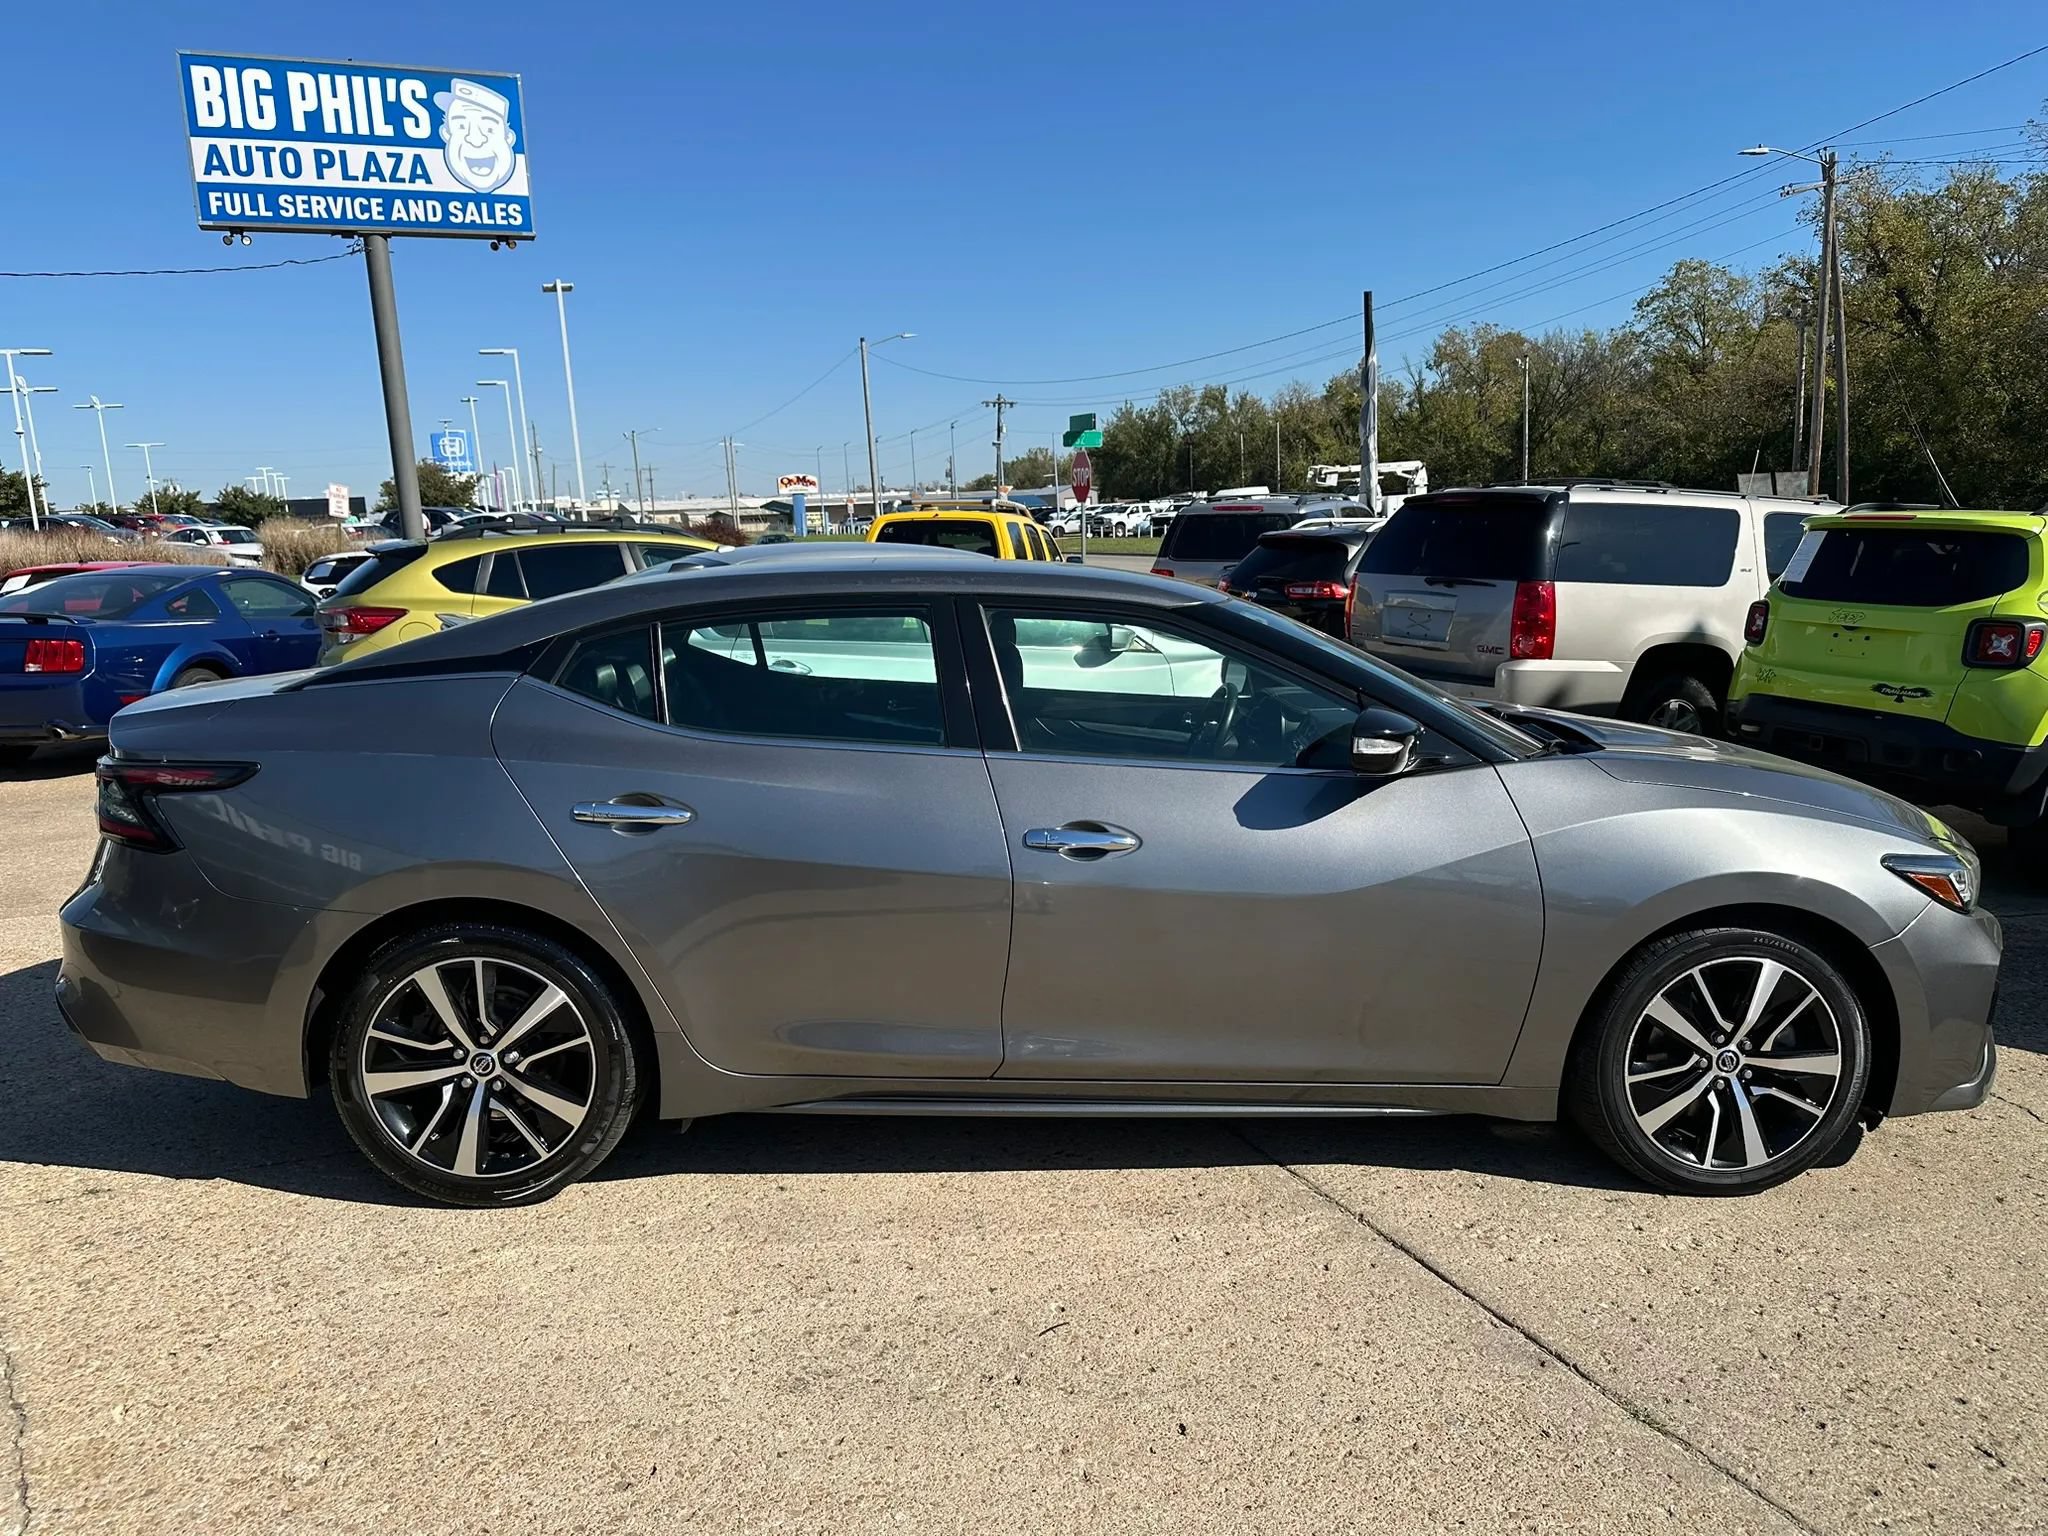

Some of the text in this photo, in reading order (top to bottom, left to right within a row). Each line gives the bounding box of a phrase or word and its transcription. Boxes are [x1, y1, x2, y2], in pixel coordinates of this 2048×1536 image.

[190, 64, 431, 139] BIG PHIL'S
[203, 144, 432, 184] AUTO PLAZA
[207, 191, 523, 225] FULL SERVICE AND SALES
[1072, 467, 1090, 487] STOP
[1477, 645, 1504, 655] GMC
